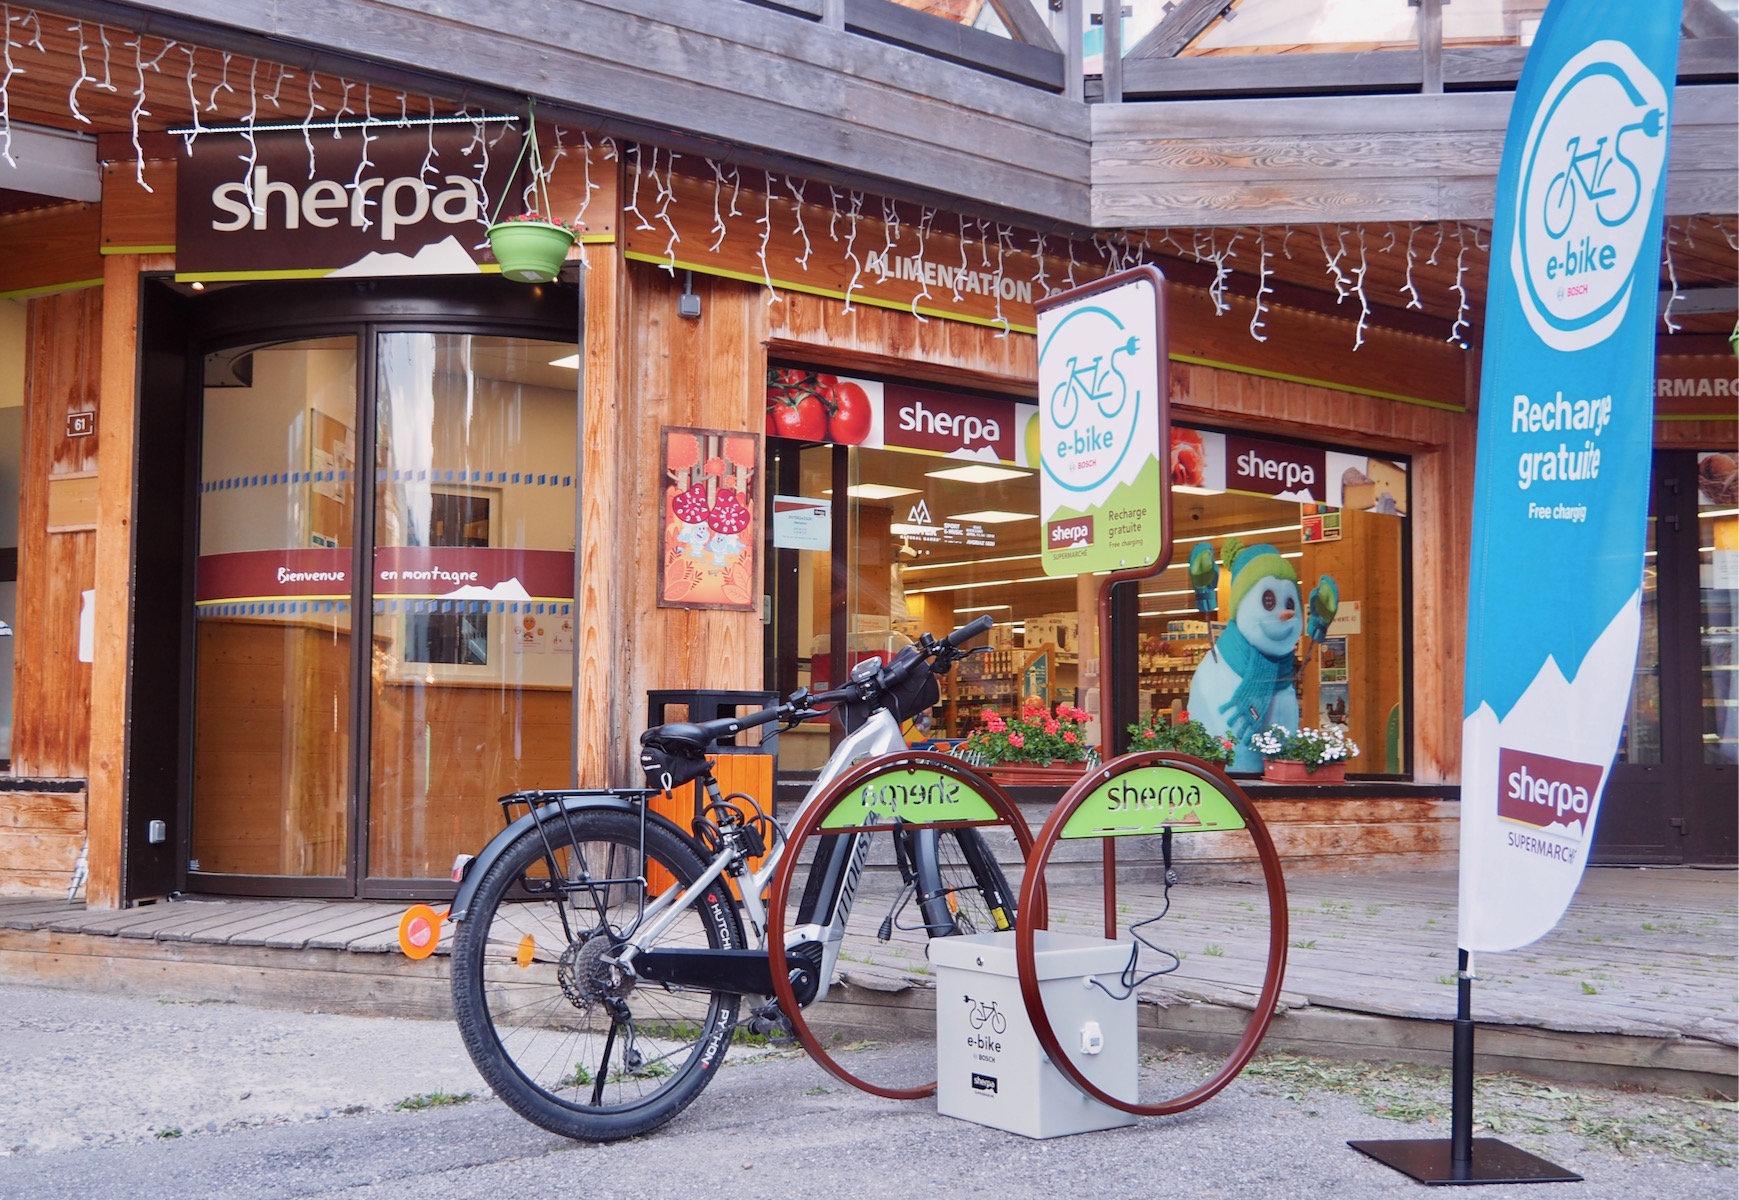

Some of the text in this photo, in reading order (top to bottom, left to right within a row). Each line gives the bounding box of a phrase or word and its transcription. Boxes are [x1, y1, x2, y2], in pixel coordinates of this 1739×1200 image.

[212, 165, 479, 241] sherpa
[1546, 235, 1617, 280] e-bike
[864, 250, 1032, 304] ALIMENTATION
[1567, 284, 1588, 297] BOSCH
[74, 418, 86, 431] 61
[899, 401, 1000, 444] sherpa
[1057, 425, 1113, 458] e-bike
[1078, 459, 1097, 470] BOSCH
[1237, 450, 1315, 488] sherpa
[1518, 440, 1601, 490] gratuite
[1108, 507, 1147, 521] Recharge
[1528, 502, 1552, 519] Free
[1052, 525, 1088, 542] sherpa
[1108, 522, 1142, 539] gratuite
[1109, 538, 1144, 549] Free charging
[277, 566, 478, 585] Bienvenue en montagne
[1107, 779, 1201, 815] sherpa
[1508, 765, 1589, 817] sherpa
[967, 1033, 1002, 1053] e-bike
[978, 1054, 996, 1063] BOSCH
[973, 1076, 996, 1089] sherpa
